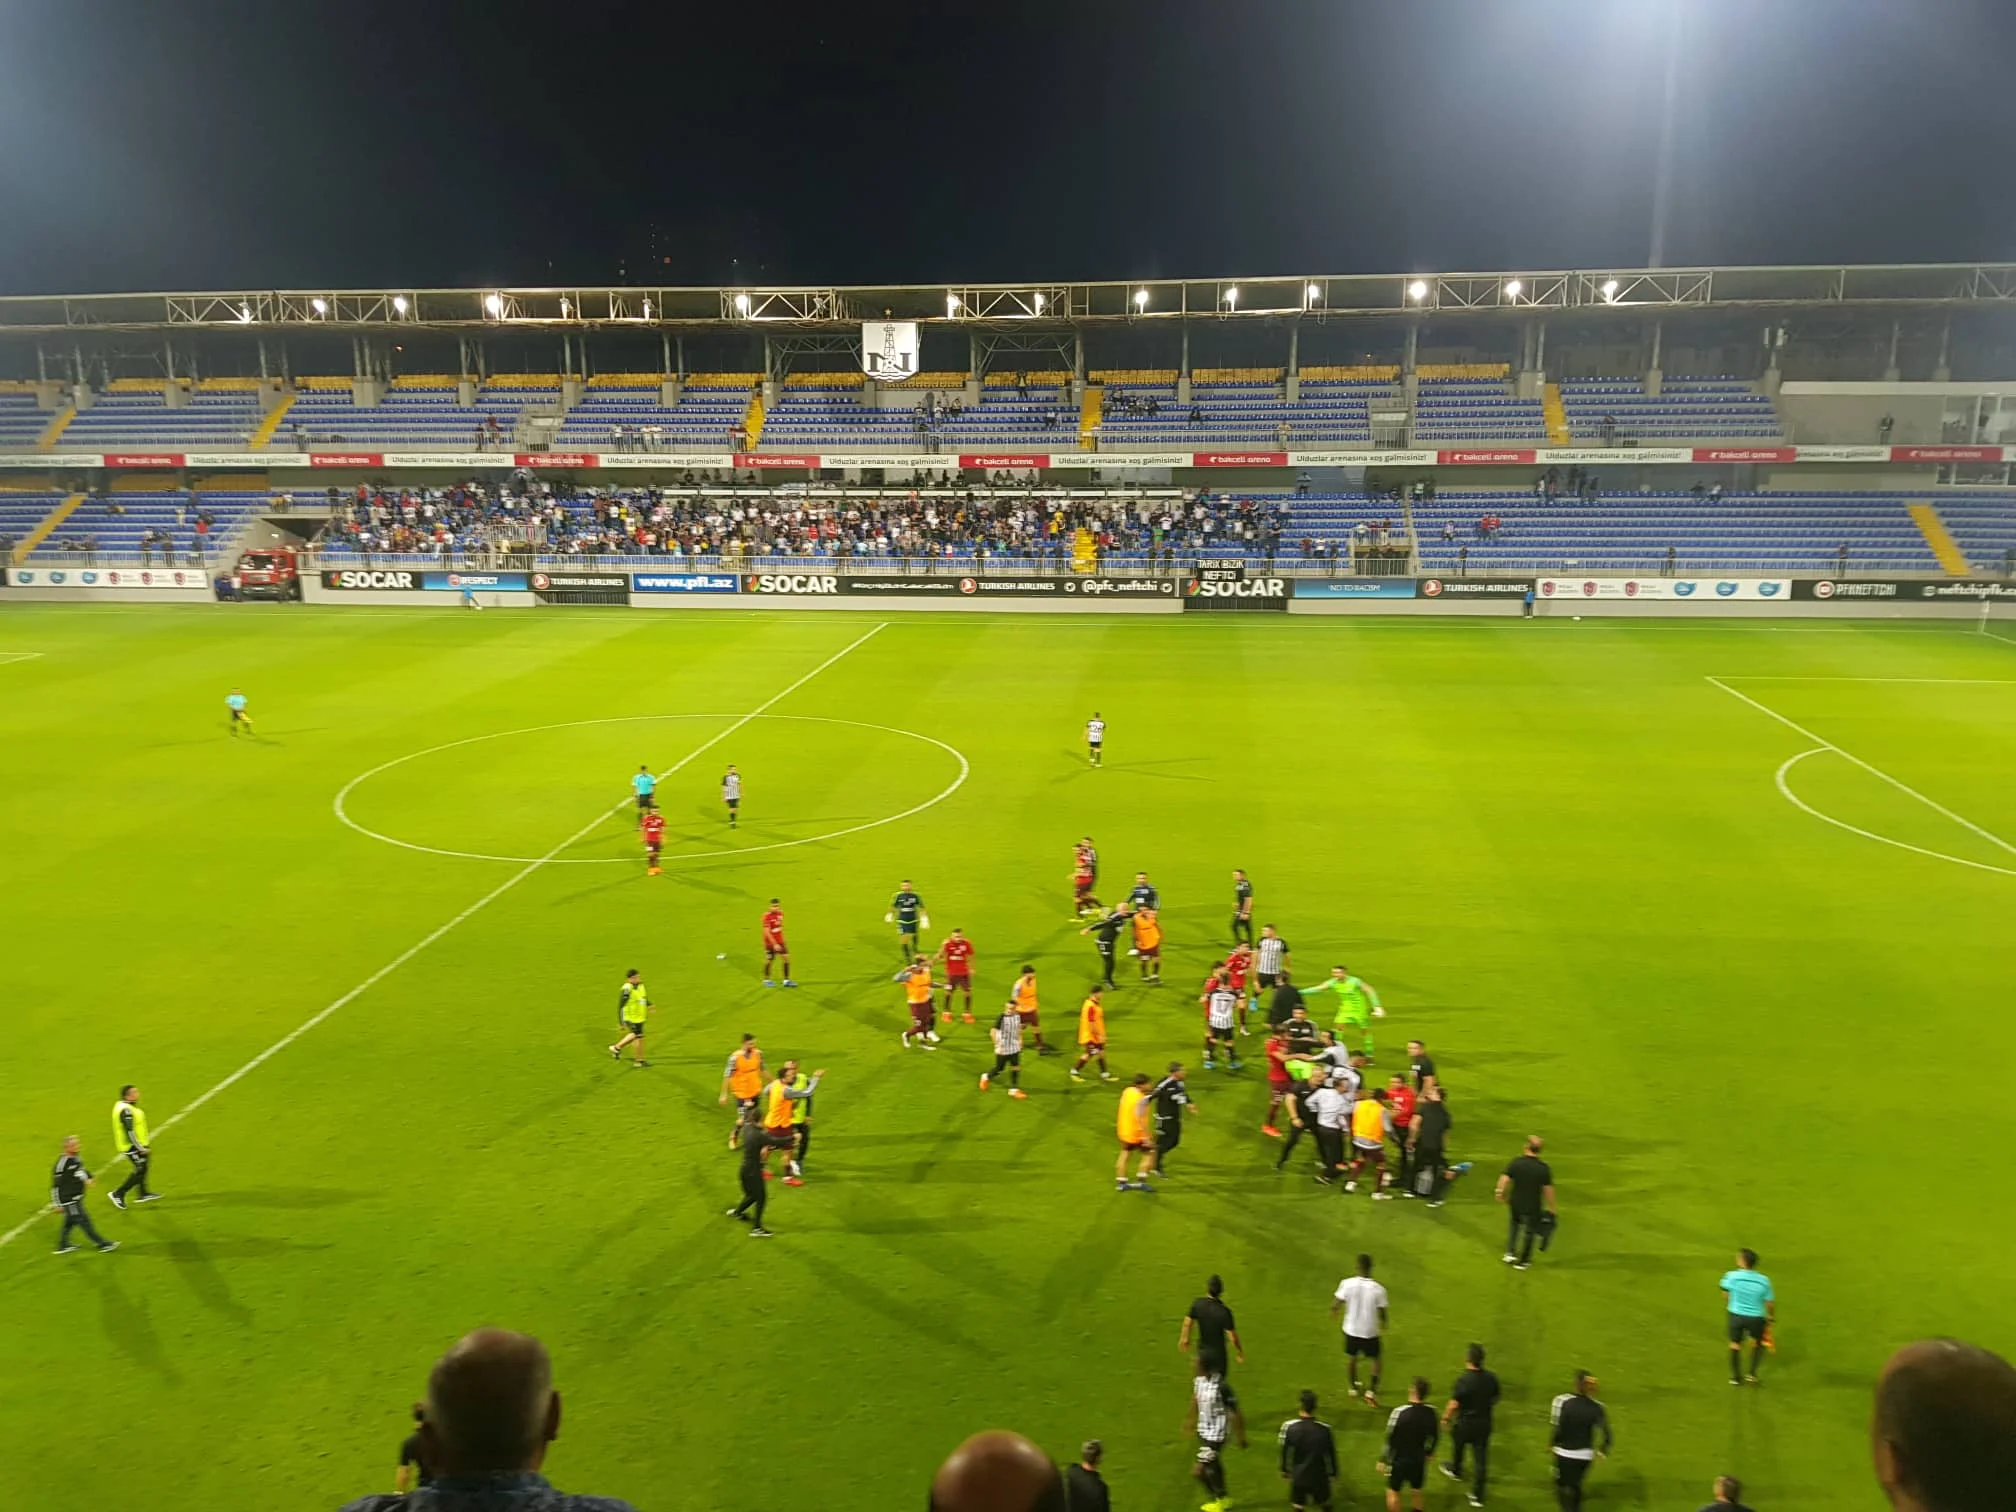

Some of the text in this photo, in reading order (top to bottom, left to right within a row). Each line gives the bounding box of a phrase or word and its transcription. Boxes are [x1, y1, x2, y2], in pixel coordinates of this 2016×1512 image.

[341, 571, 413, 588] SOCAR
[461, 576, 498, 585] RESPECT
[588, 578, 625, 586] AIRLINES
[638, 576, 734, 590] www.pfl.az
[760, 575, 838, 593] SOCAR
[978, 582, 1055, 590] TURKISH AIRLINES
[1082, 580, 1158, 594] @pfc_neftchi
[1200, 578, 1284, 597] SOCAR
[1486, 584, 1529, 592] AIRLINES
